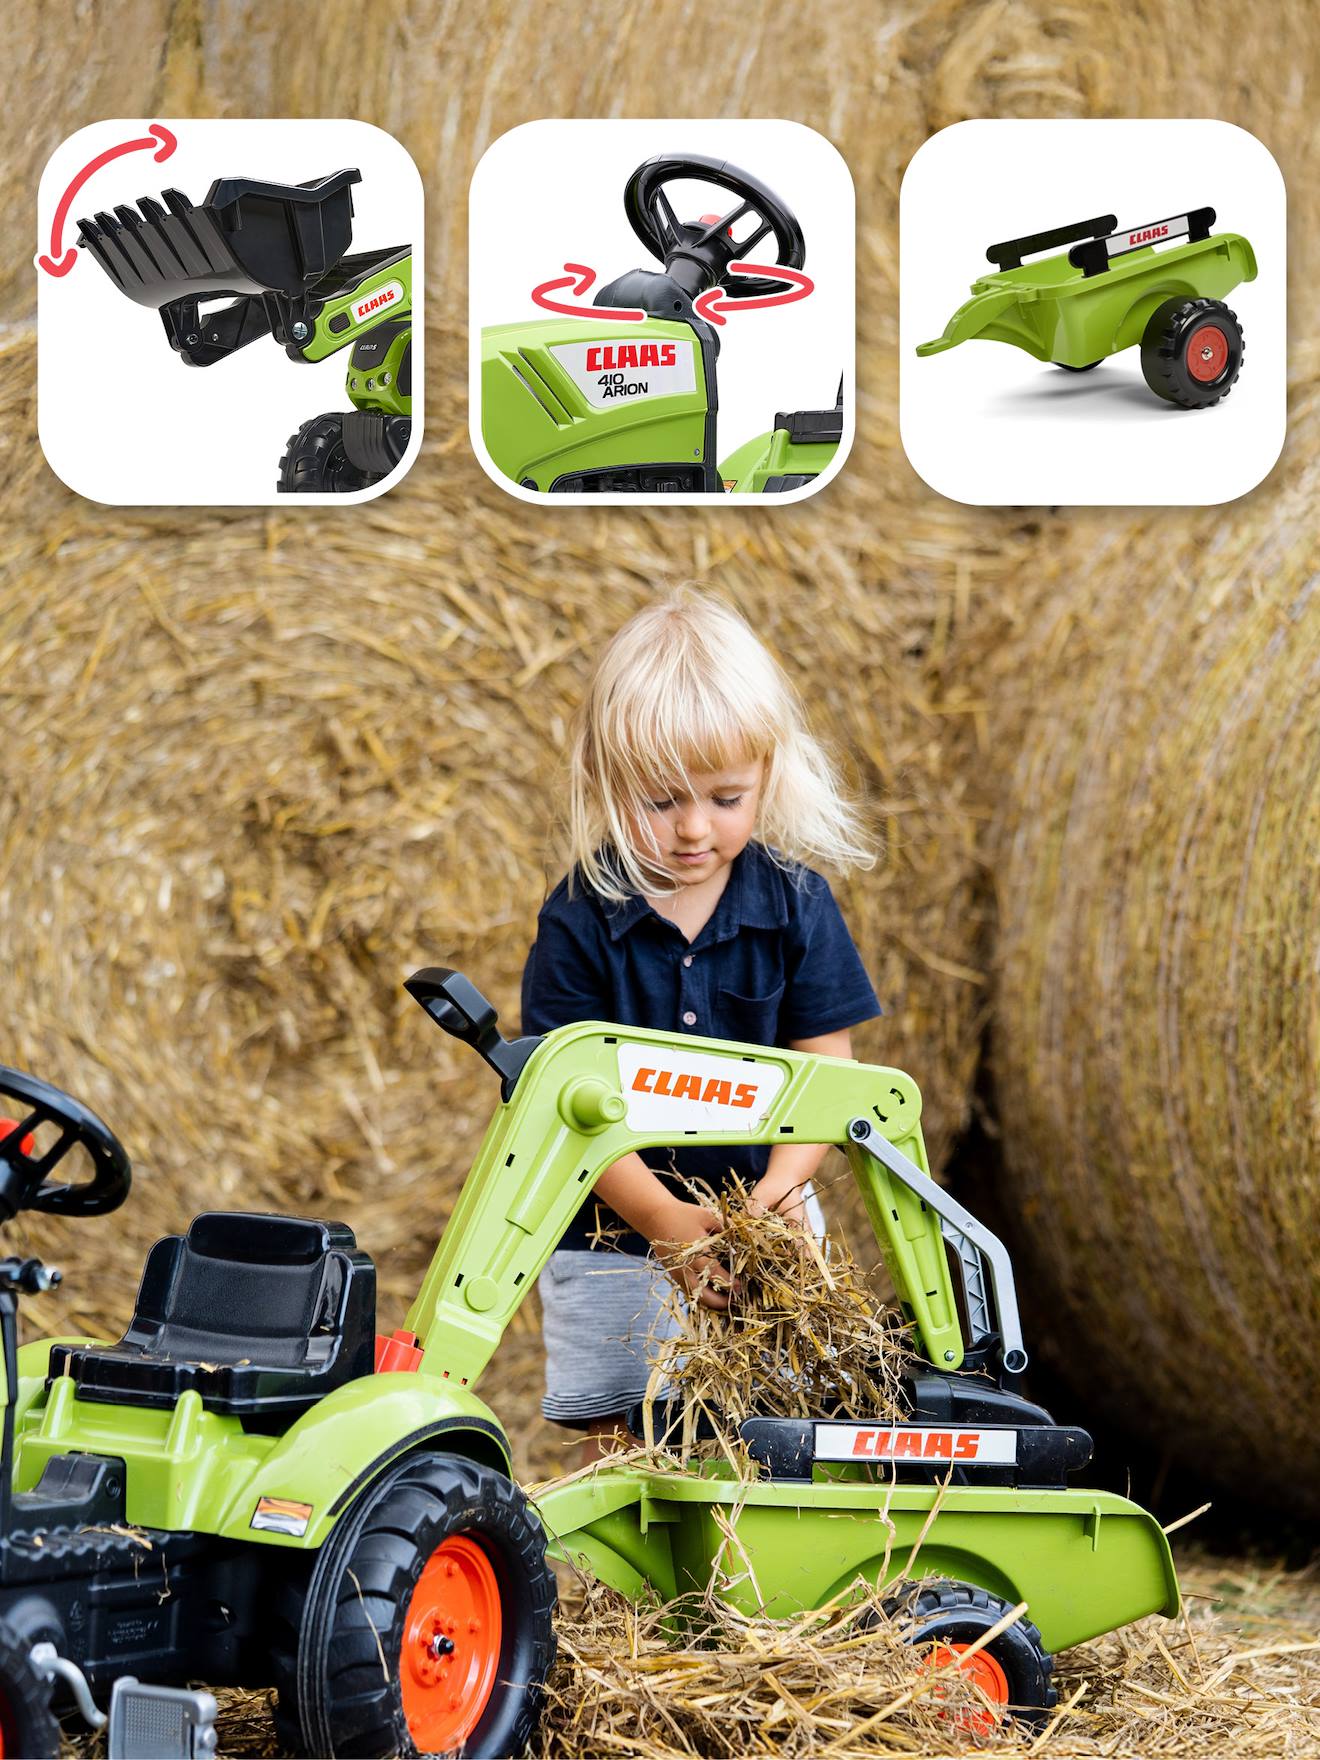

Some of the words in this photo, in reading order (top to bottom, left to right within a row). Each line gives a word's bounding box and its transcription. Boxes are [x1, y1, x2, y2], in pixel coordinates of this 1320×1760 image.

[1130, 225, 1168, 245] CLAAS
[357, 290, 395, 316] CLAAS
[587, 345, 676, 371] CLAAS
[598, 373, 624, 386] 410
[602, 382, 648, 398] ARION
[631, 1067, 758, 1109] CLAAS
[852, 1431, 980, 1459] CLAAS
